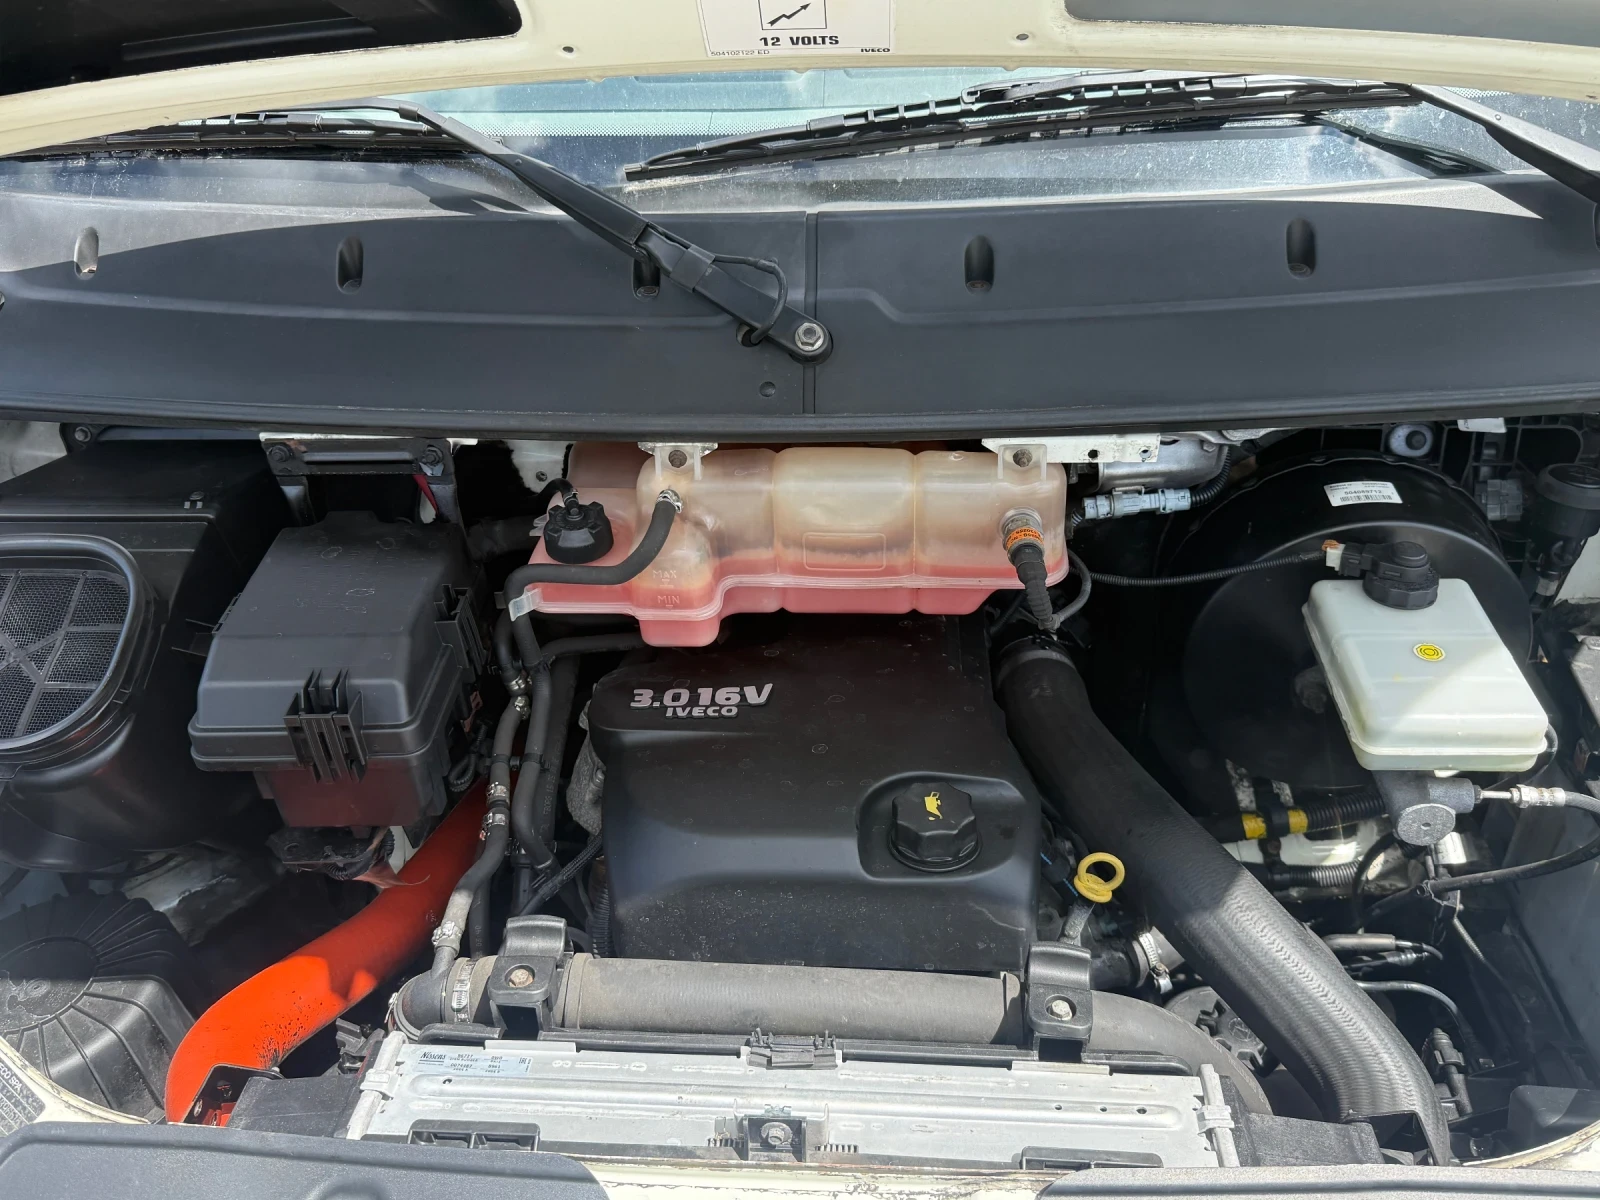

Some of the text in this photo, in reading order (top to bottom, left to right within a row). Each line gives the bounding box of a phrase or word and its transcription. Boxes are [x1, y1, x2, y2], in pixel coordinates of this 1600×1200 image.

[759, 35, 840, 47] 12 VOLTS
[652, 569, 677, 579] MAX
[657, 595, 680, 604] MIN
[665, 706, 739, 718] IVECO
[420, 1051, 447, 1060] Nissens
